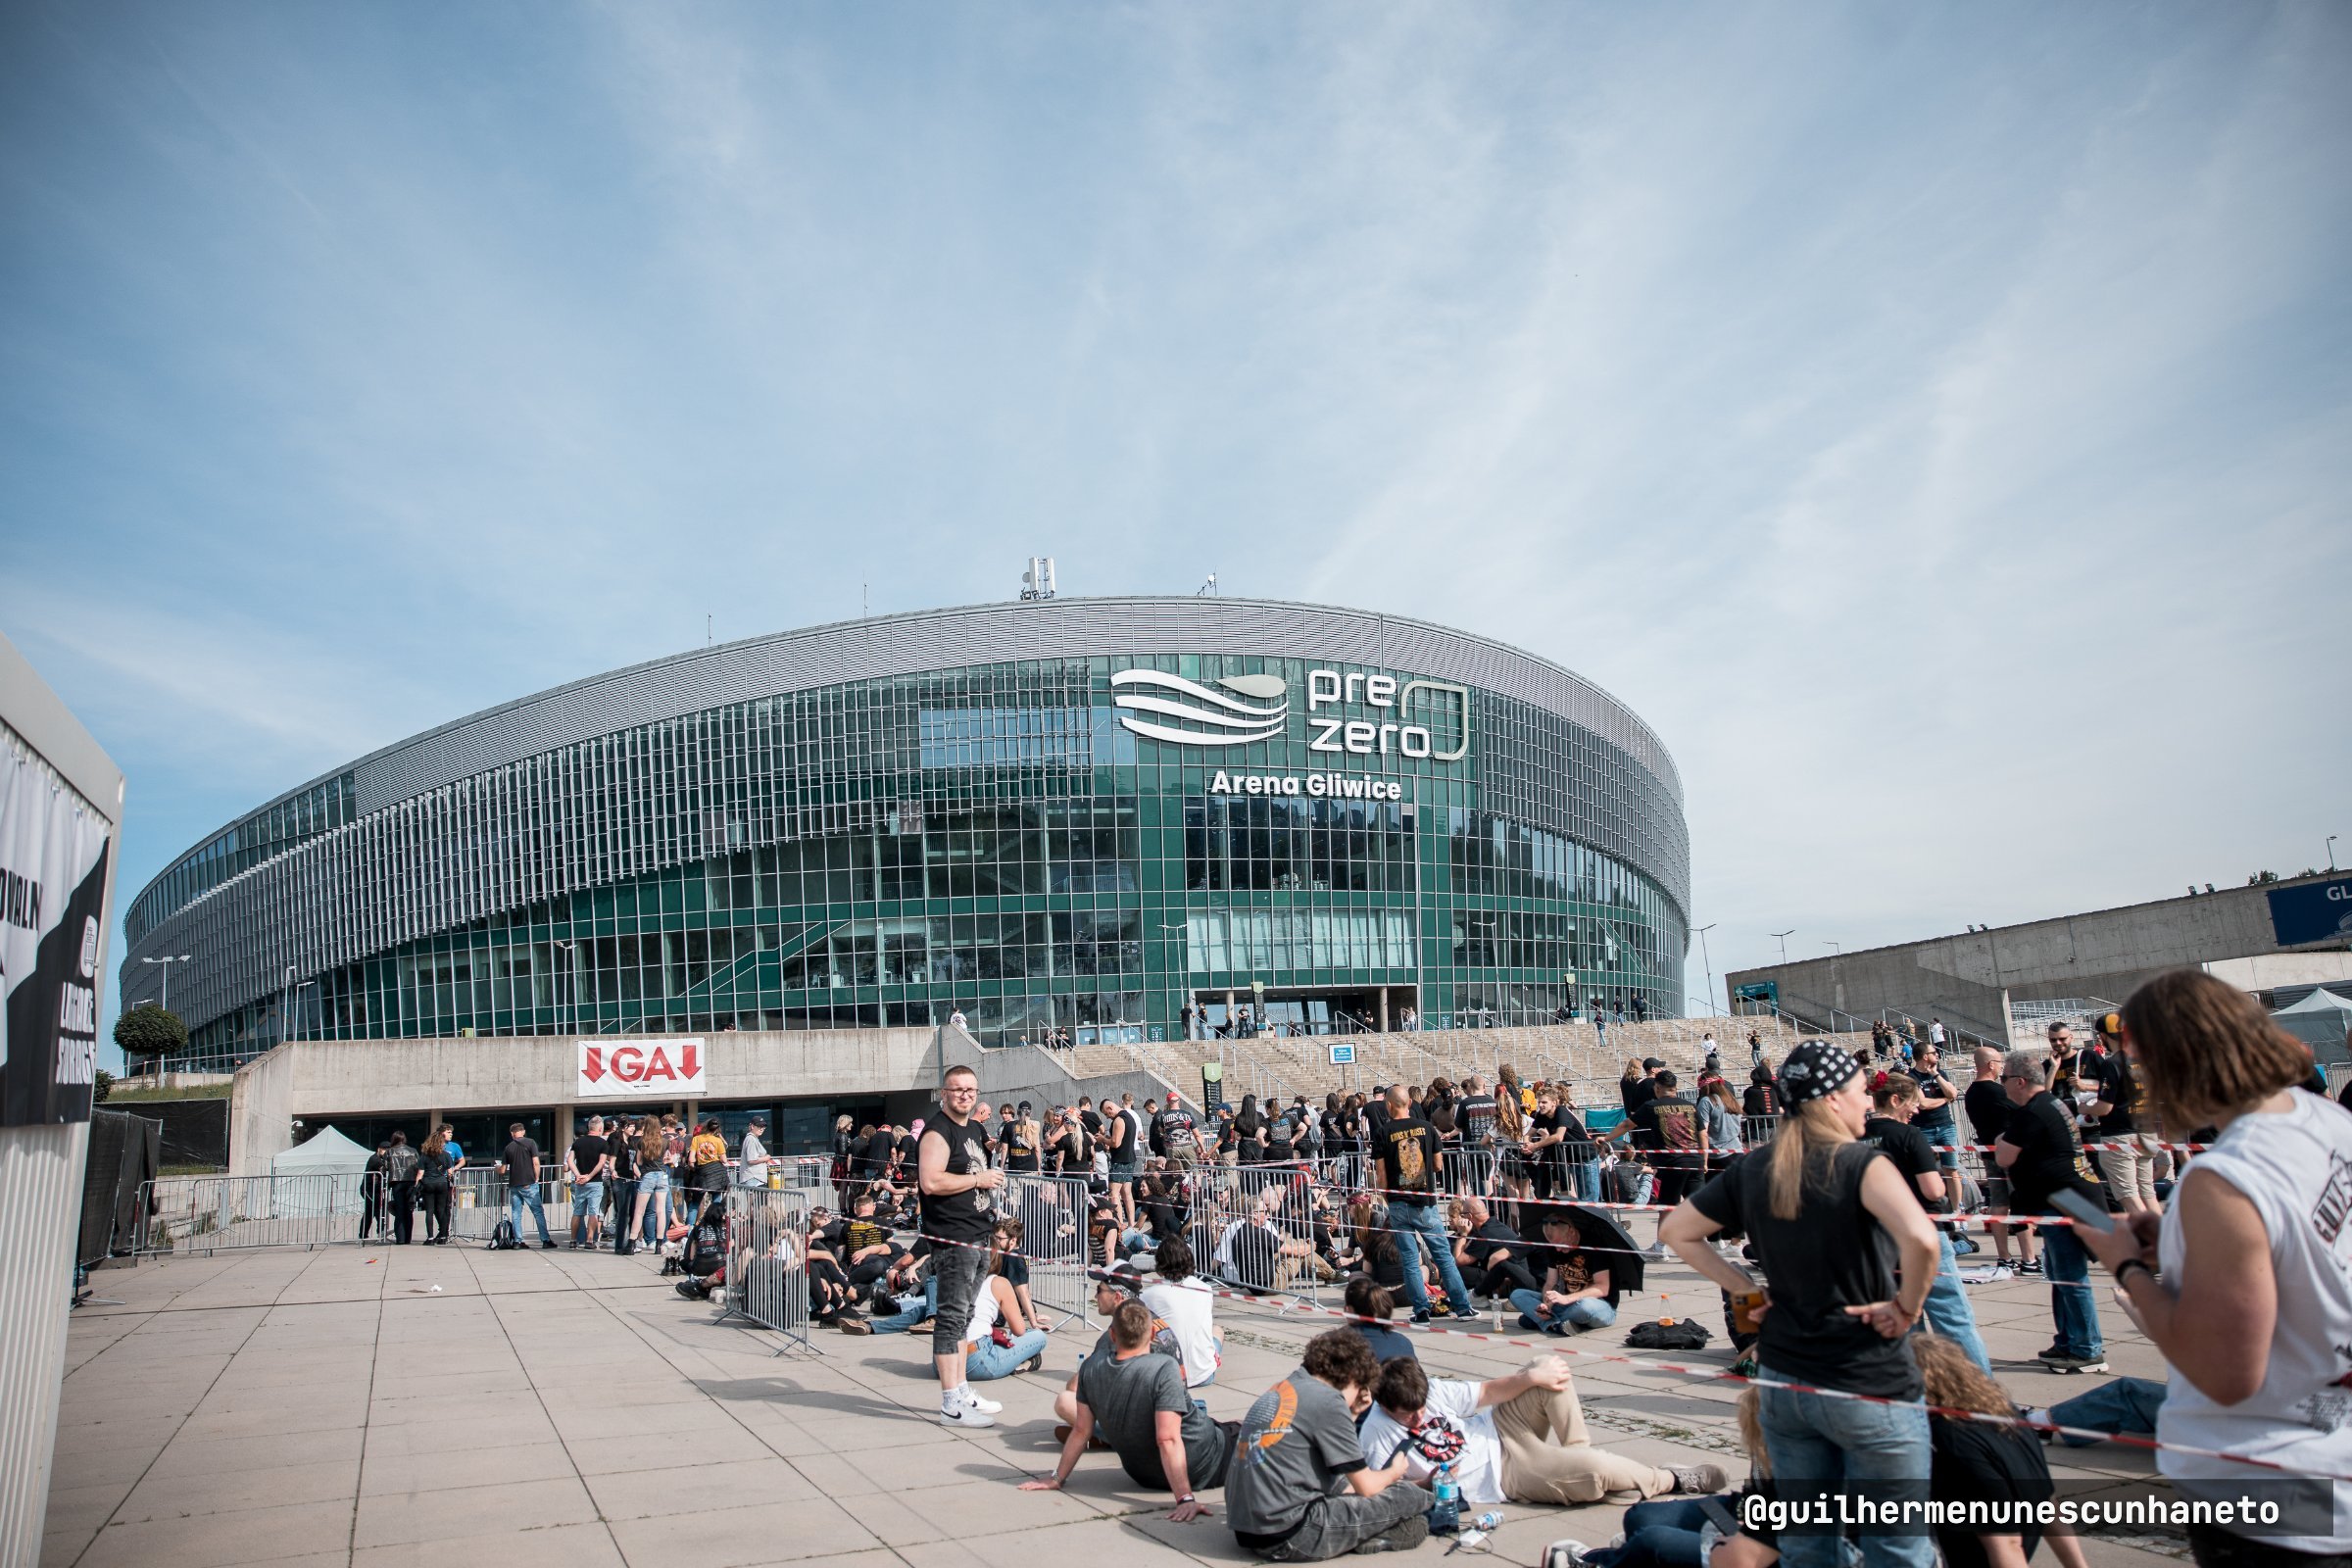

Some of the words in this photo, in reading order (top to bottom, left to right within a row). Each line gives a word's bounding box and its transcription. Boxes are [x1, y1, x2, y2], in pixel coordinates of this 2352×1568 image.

[1308, 669, 1396, 710] pre
[1309, 718, 1430, 758] zero
[1210, 770, 1299, 796] Arena
[1306, 773, 1402, 800] Gliwice
[611, 1046, 677, 1082] GA
